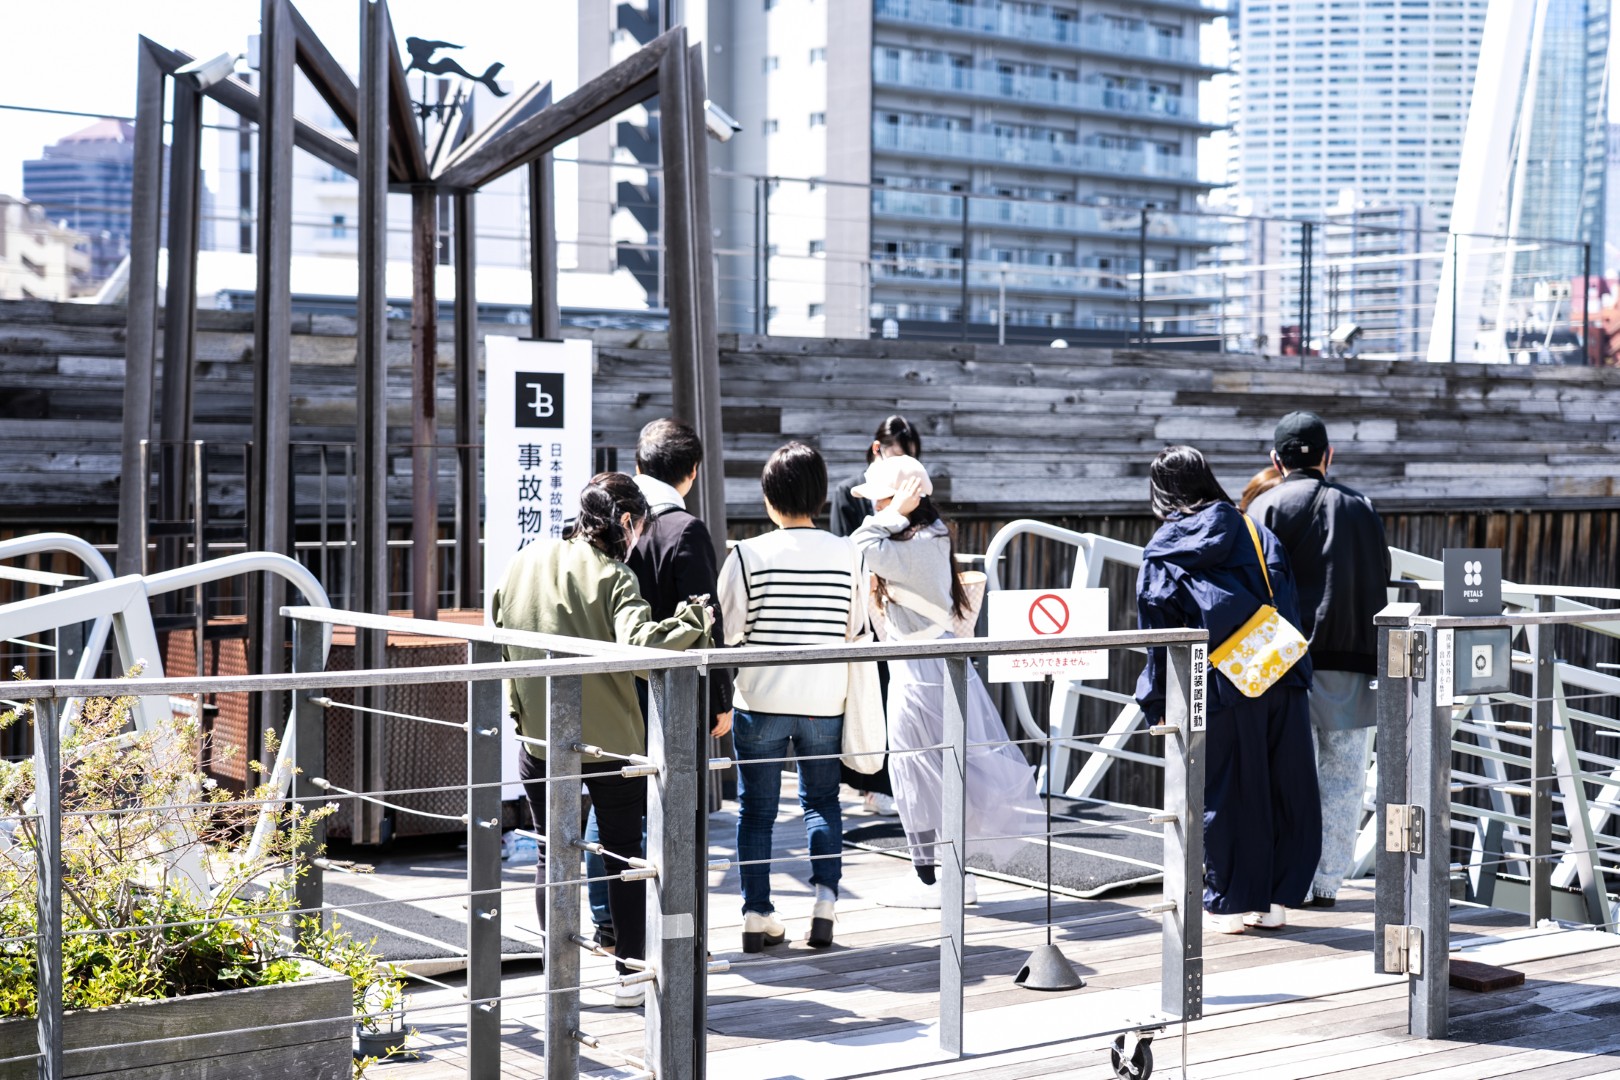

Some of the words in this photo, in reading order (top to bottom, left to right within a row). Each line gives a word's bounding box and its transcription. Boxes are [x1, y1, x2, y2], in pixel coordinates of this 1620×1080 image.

[1463, 590, 1483, 598] PETALS
[1012, 657, 1090, 668] 立ち入りできません。
[1194, 648, 1204, 727] 防犯装置作動
